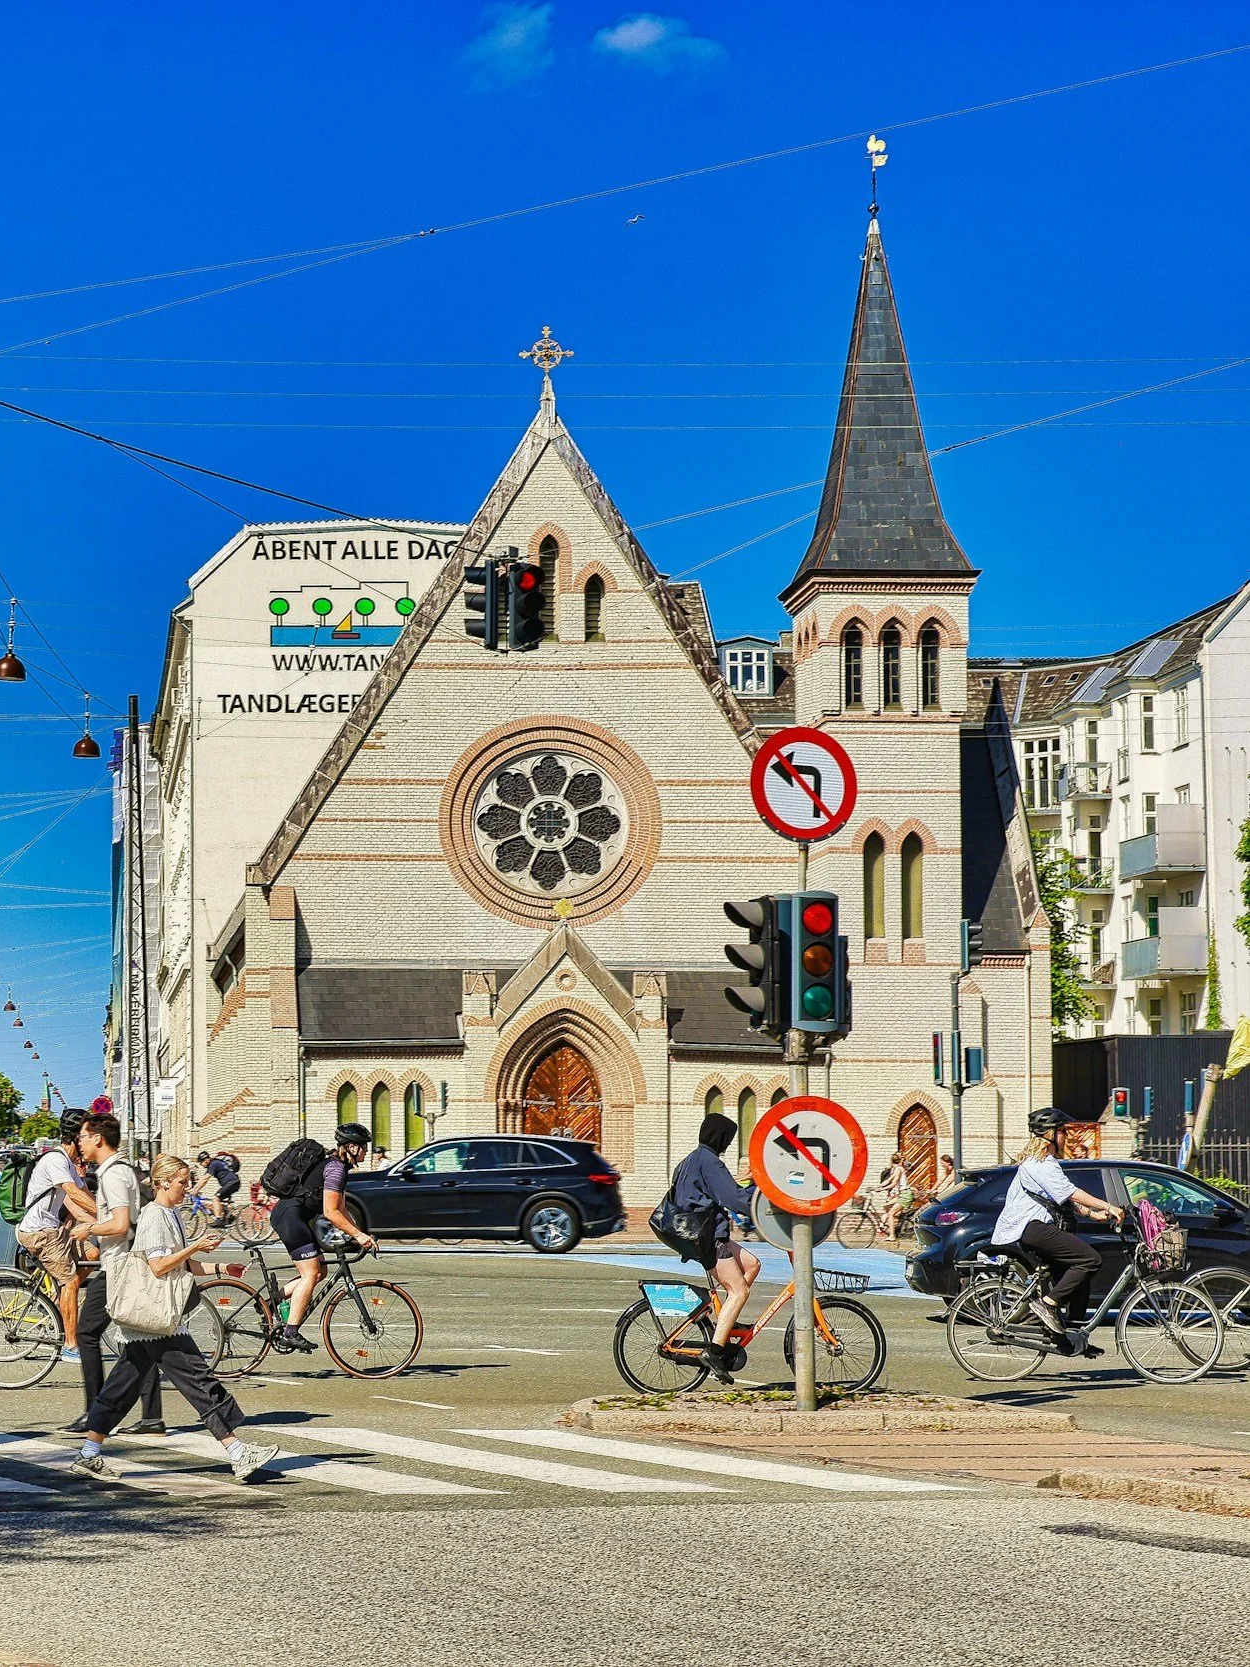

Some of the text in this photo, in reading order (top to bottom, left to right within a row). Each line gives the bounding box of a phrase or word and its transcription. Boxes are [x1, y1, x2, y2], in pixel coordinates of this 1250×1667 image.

[252, 534, 338, 560] ÅBENT
[342, 540, 399, 560] ALLE
[272, 654, 384, 671] WWW.TAN
